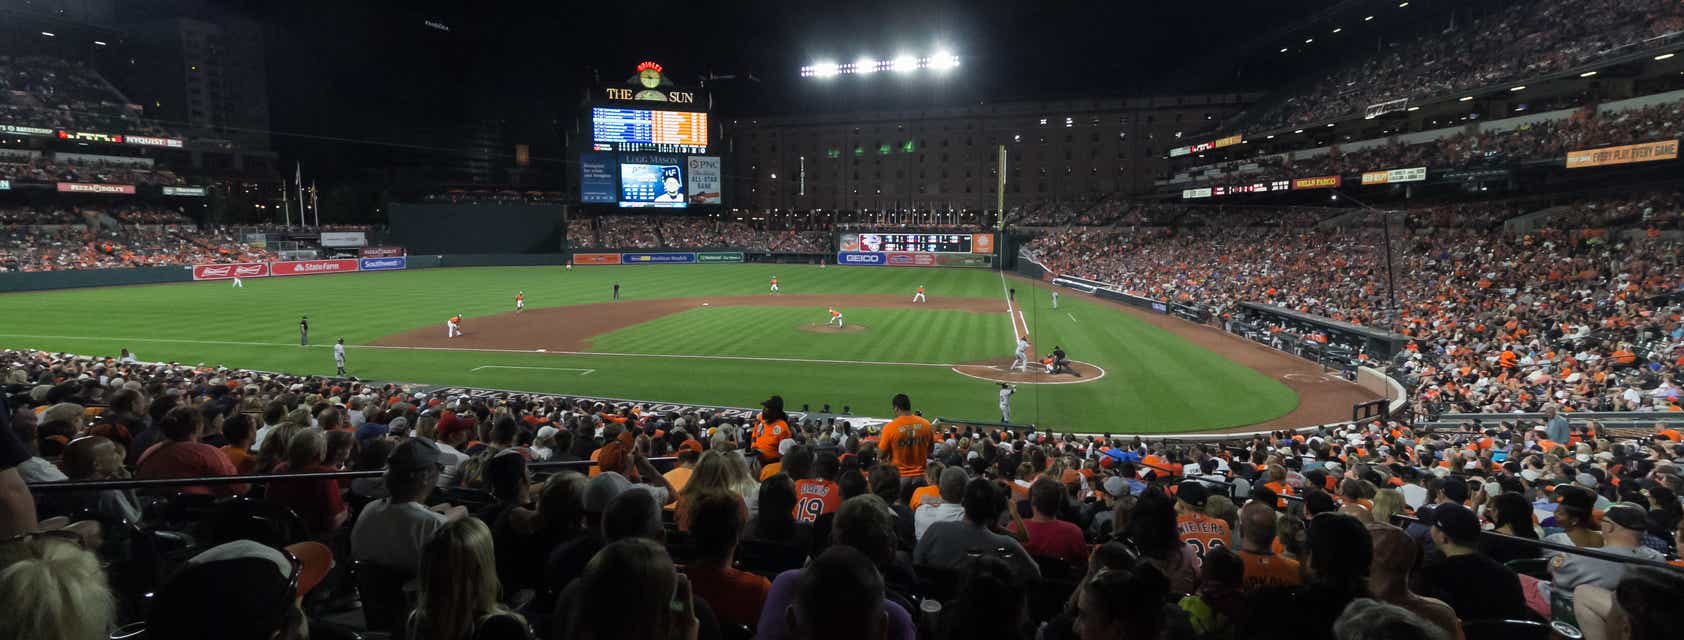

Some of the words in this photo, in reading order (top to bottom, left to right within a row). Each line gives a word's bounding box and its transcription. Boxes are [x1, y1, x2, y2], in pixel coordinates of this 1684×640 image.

[606, 88, 633, 100] THE
[669, 91, 694, 104] SUN
[700, 160, 718, 169] PNC
[846, 254, 879, 263] GEICO
[797, 496, 824, 522] 19
